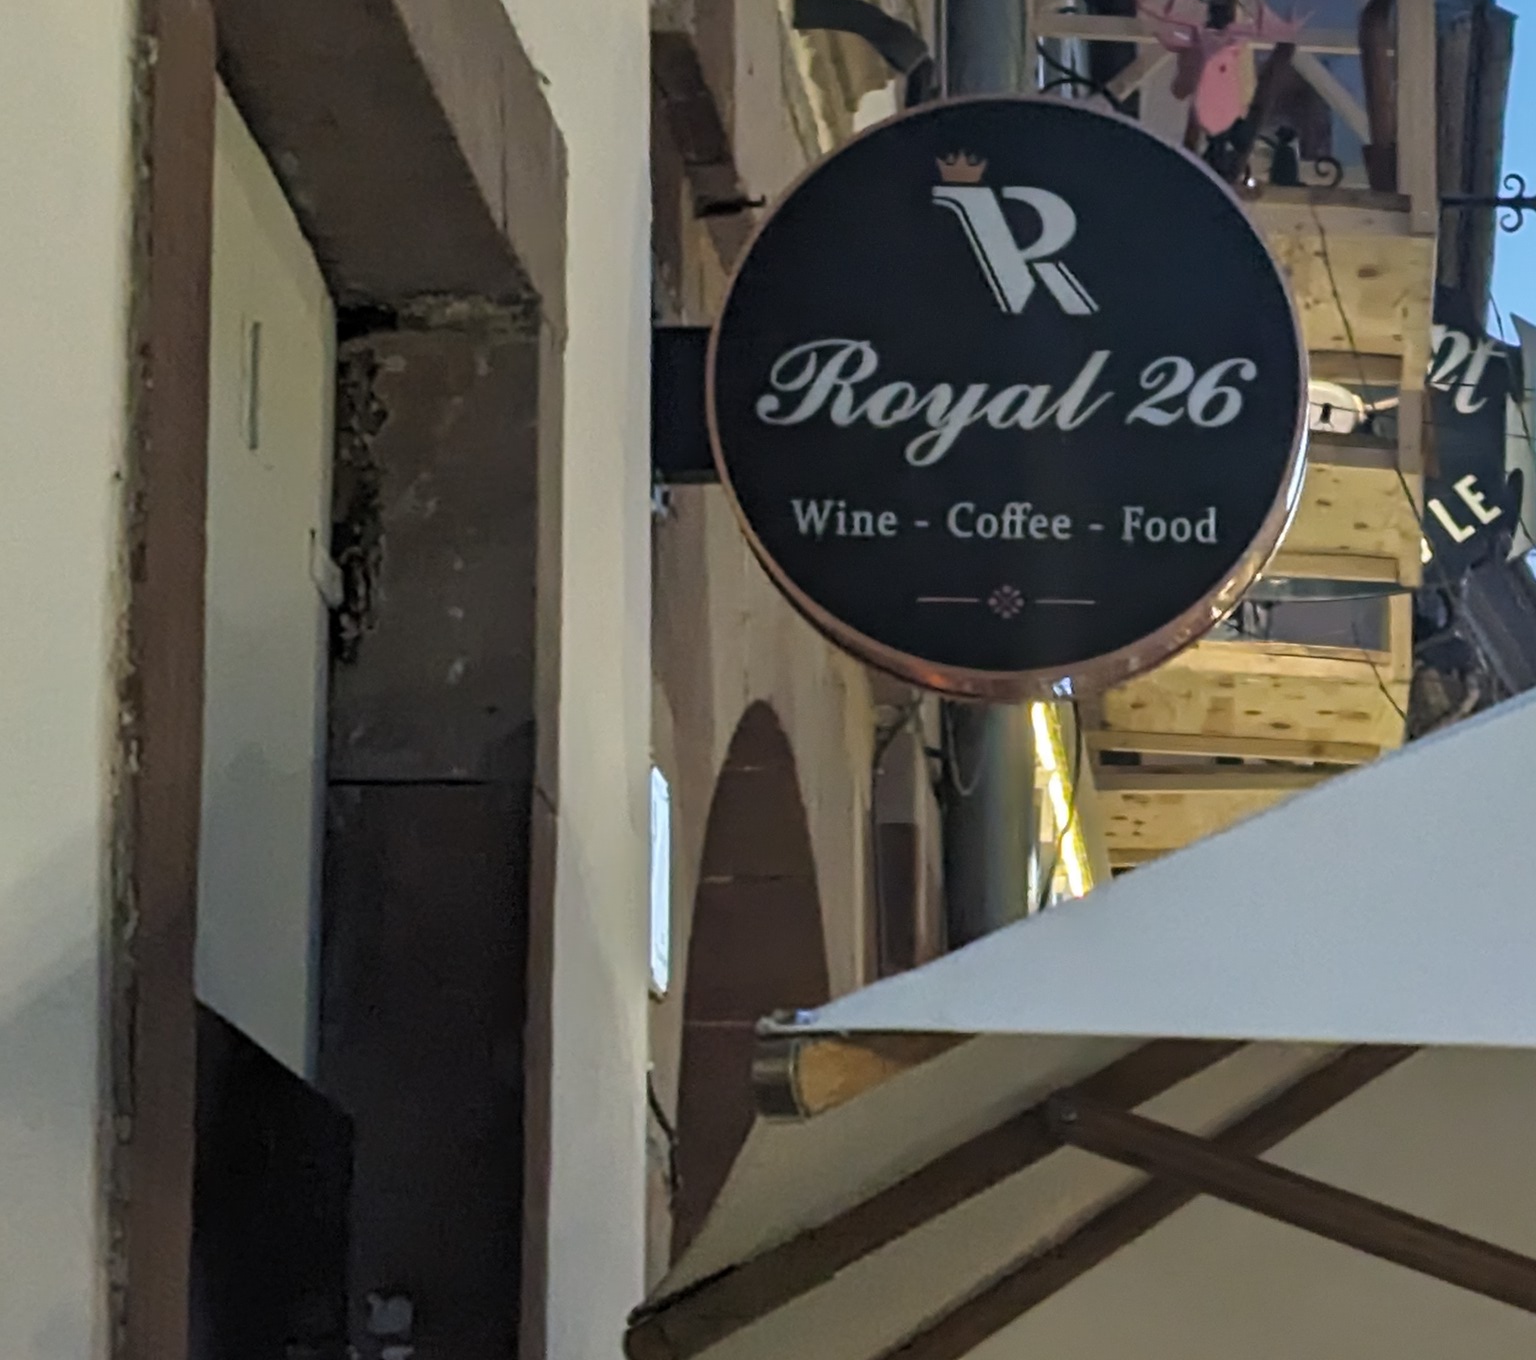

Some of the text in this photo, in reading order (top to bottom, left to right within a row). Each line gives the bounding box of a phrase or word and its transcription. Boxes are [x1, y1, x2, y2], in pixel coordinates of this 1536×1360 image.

[755, 338, 1258, 467] Royal 26
[791, 498, 898, 538] Wine
[946, 501, 1073, 540] Coffee
[1121, 506, 1218, 544] Food
[1420, 474, 1502, 564] LE
